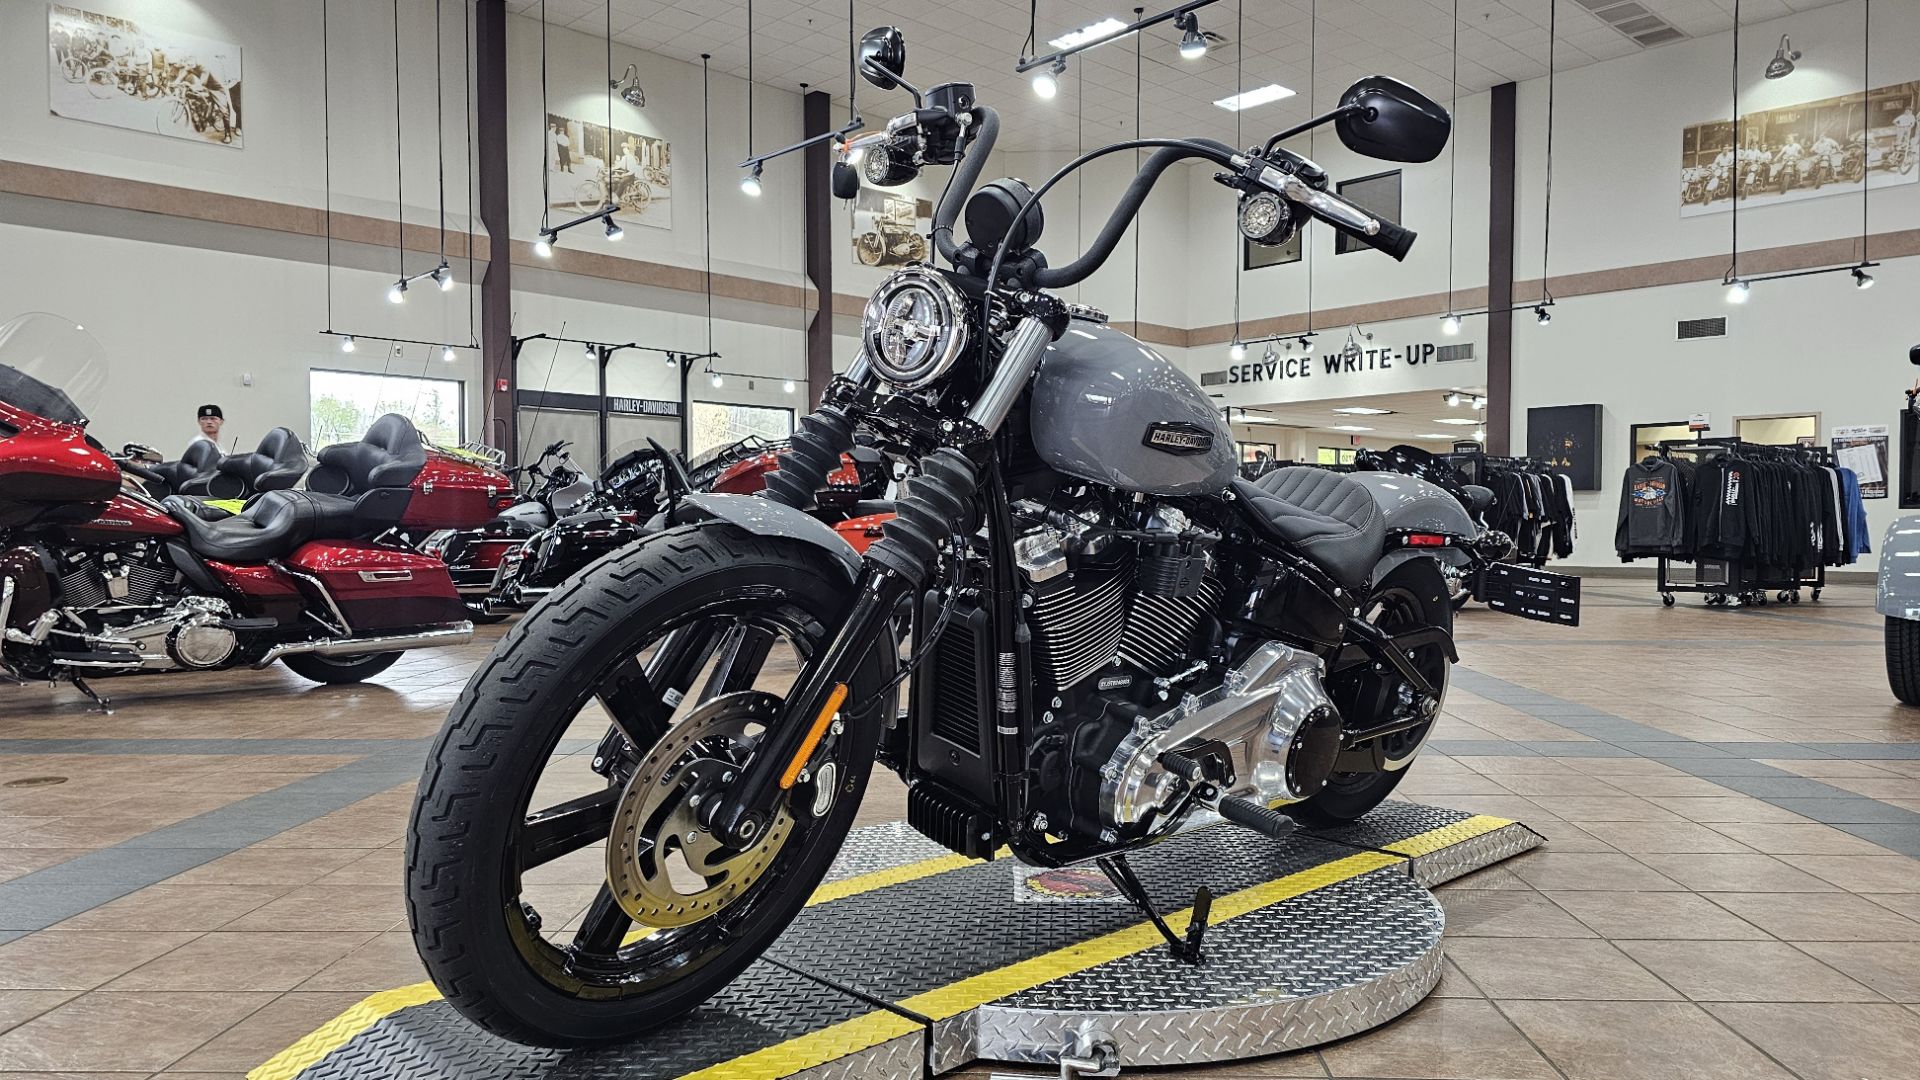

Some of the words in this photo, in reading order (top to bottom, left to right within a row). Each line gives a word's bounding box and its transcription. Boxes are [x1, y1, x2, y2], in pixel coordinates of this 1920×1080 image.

[1229, 357, 1311, 384] SERVICE
[1323, 343, 1436, 374] WRITE-UP
[613, 398, 678, 415] HARLEY-DAVIDSON
[1153, 431, 1212, 449] HARLEY-DAVIDSON
